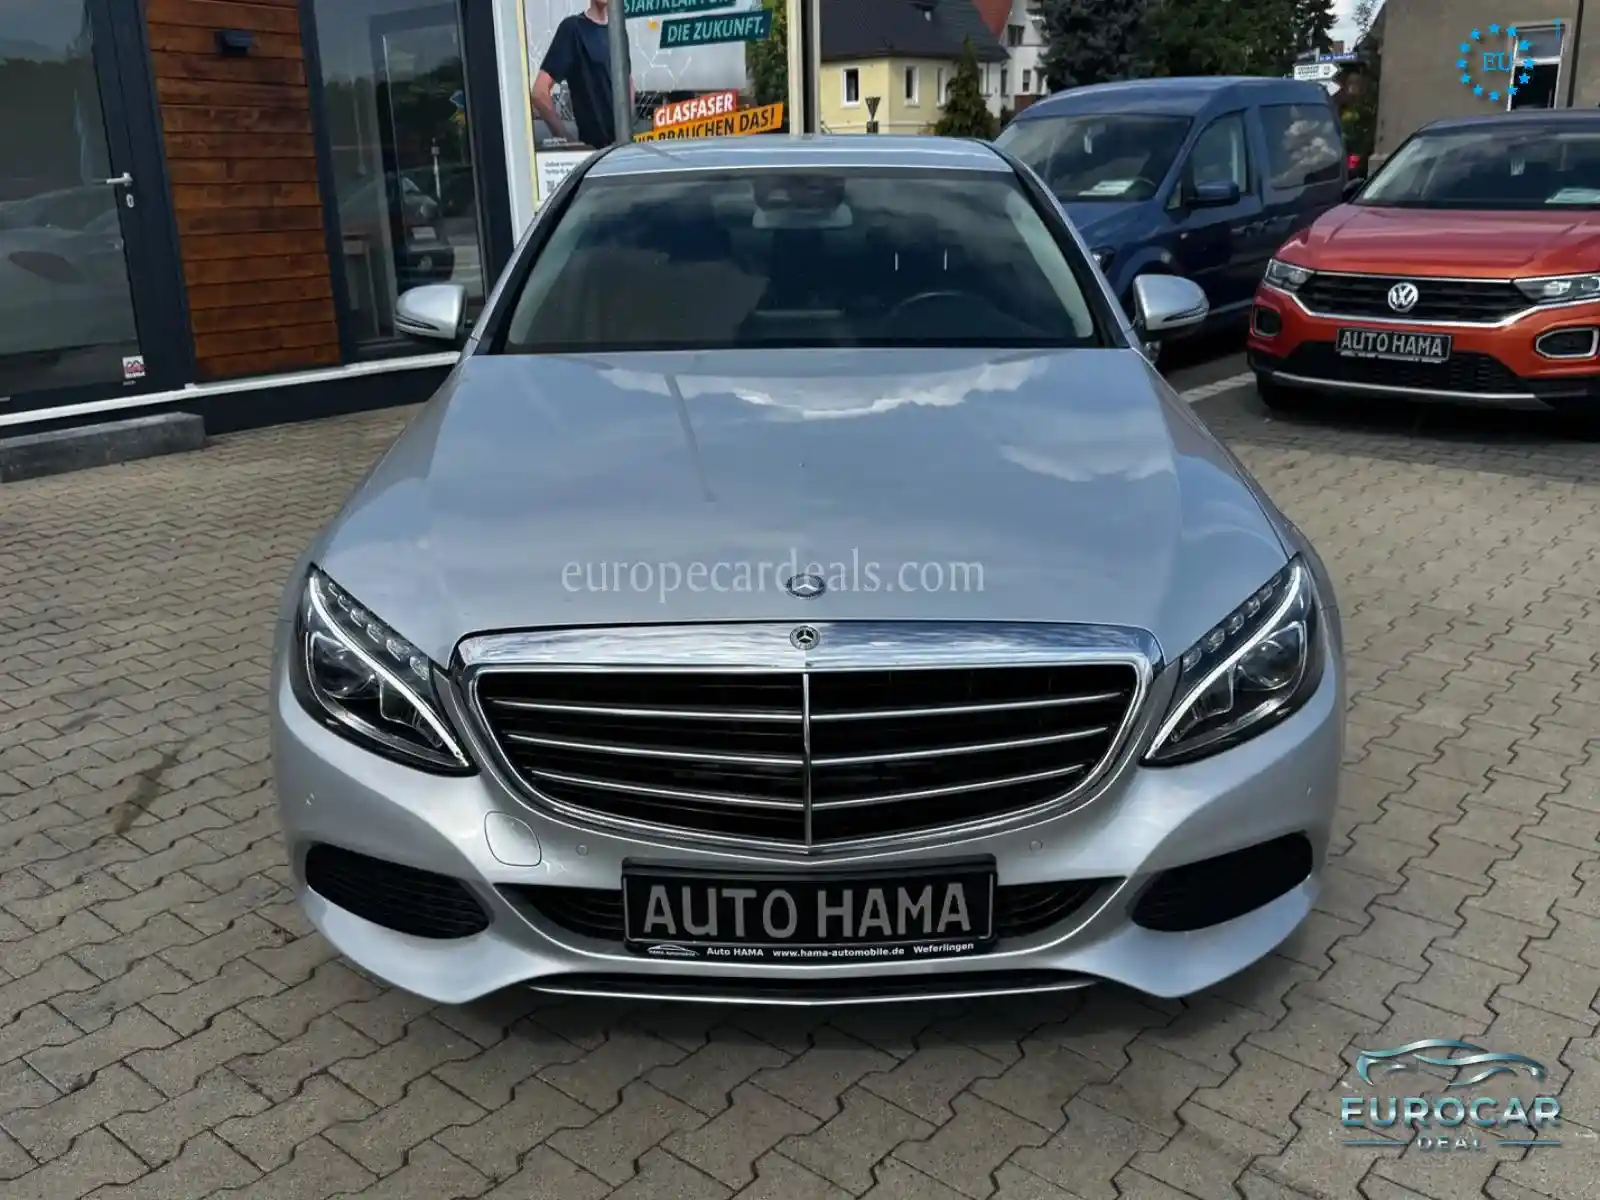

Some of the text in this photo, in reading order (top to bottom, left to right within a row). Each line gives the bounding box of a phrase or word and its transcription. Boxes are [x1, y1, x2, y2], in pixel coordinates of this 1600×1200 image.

[667, 16, 764, 43] DIE ZUKUNFT.
[655, 92, 733, 126] GLASFASER
[739, 107, 774, 132] DAS!
[1341, 331, 1442, 356] AUTO HAMA
[643, 882, 972, 939] AUTO HAMA
[706, 947, 731, 957] Auto
[733, 948, 764, 957] HAMA
[773, 947, 905, 958] www.hama-automobile.de
[913, 942, 975, 955] Weferlingen
